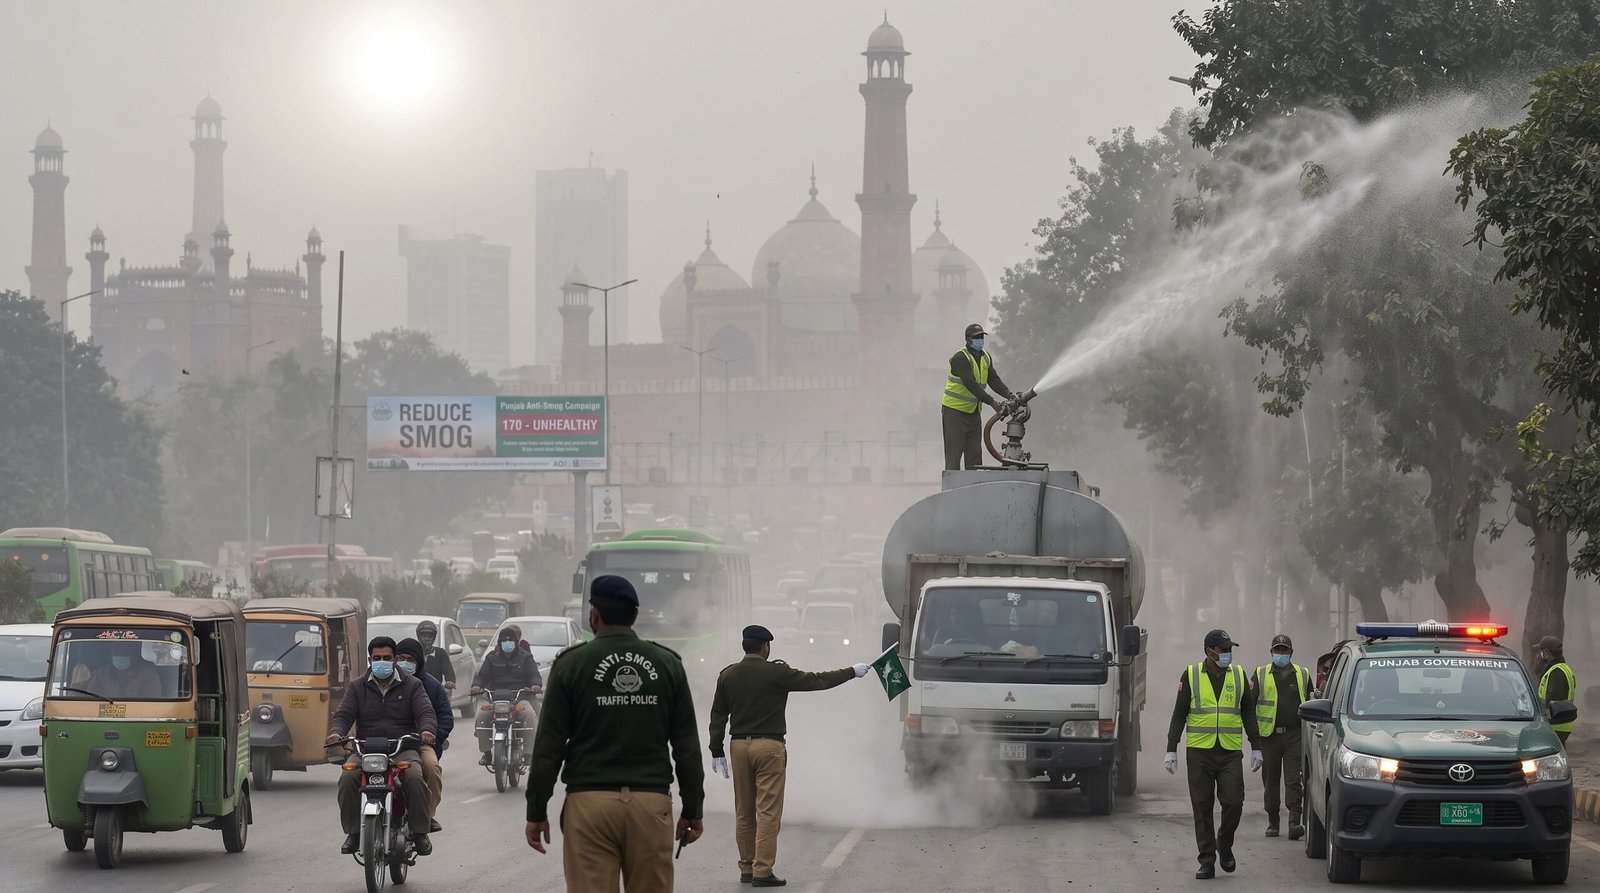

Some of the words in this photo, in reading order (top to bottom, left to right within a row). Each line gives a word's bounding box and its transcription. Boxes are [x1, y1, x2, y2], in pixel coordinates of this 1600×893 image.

[400, 403, 472, 421] REDUCE
[500, 402, 525, 411] Punjab
[526, 402, 563, 411] Anti-Smog
[502, 419, 522, 431] 170
[533, 419, 598, 431] UNHEALTHY
[399, 424, 473, 448] SMOG
[1369, 659, 1420, 668] PUNJAB
[1423, 659, 1509, 669] GOVERNMENT
[596, 695, 629, 706] TRAFFIC
[631, 695, 658, 705] POLICE
